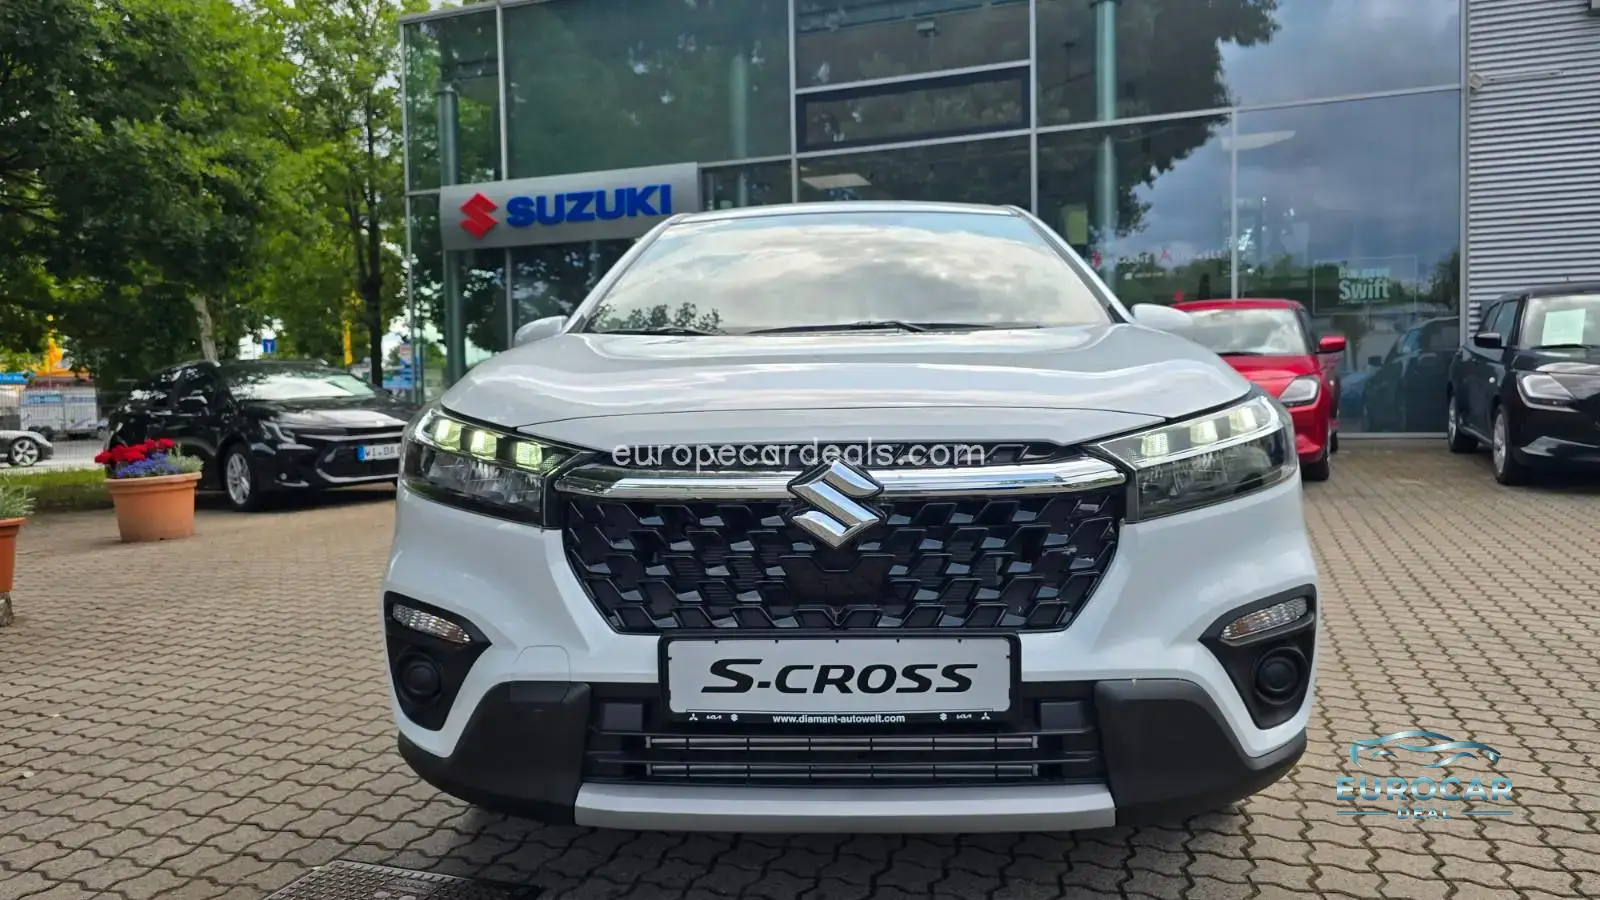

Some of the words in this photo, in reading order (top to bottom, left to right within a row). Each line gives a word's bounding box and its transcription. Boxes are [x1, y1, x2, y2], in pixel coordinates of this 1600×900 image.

[505, 183, 672, 229] SUZUKI
[1338, 278, 1391, 301] Swift
[701, 658, 978, 694] S-CROSS
[772, 713, 906, 724] www.diamant-autowelt.com
